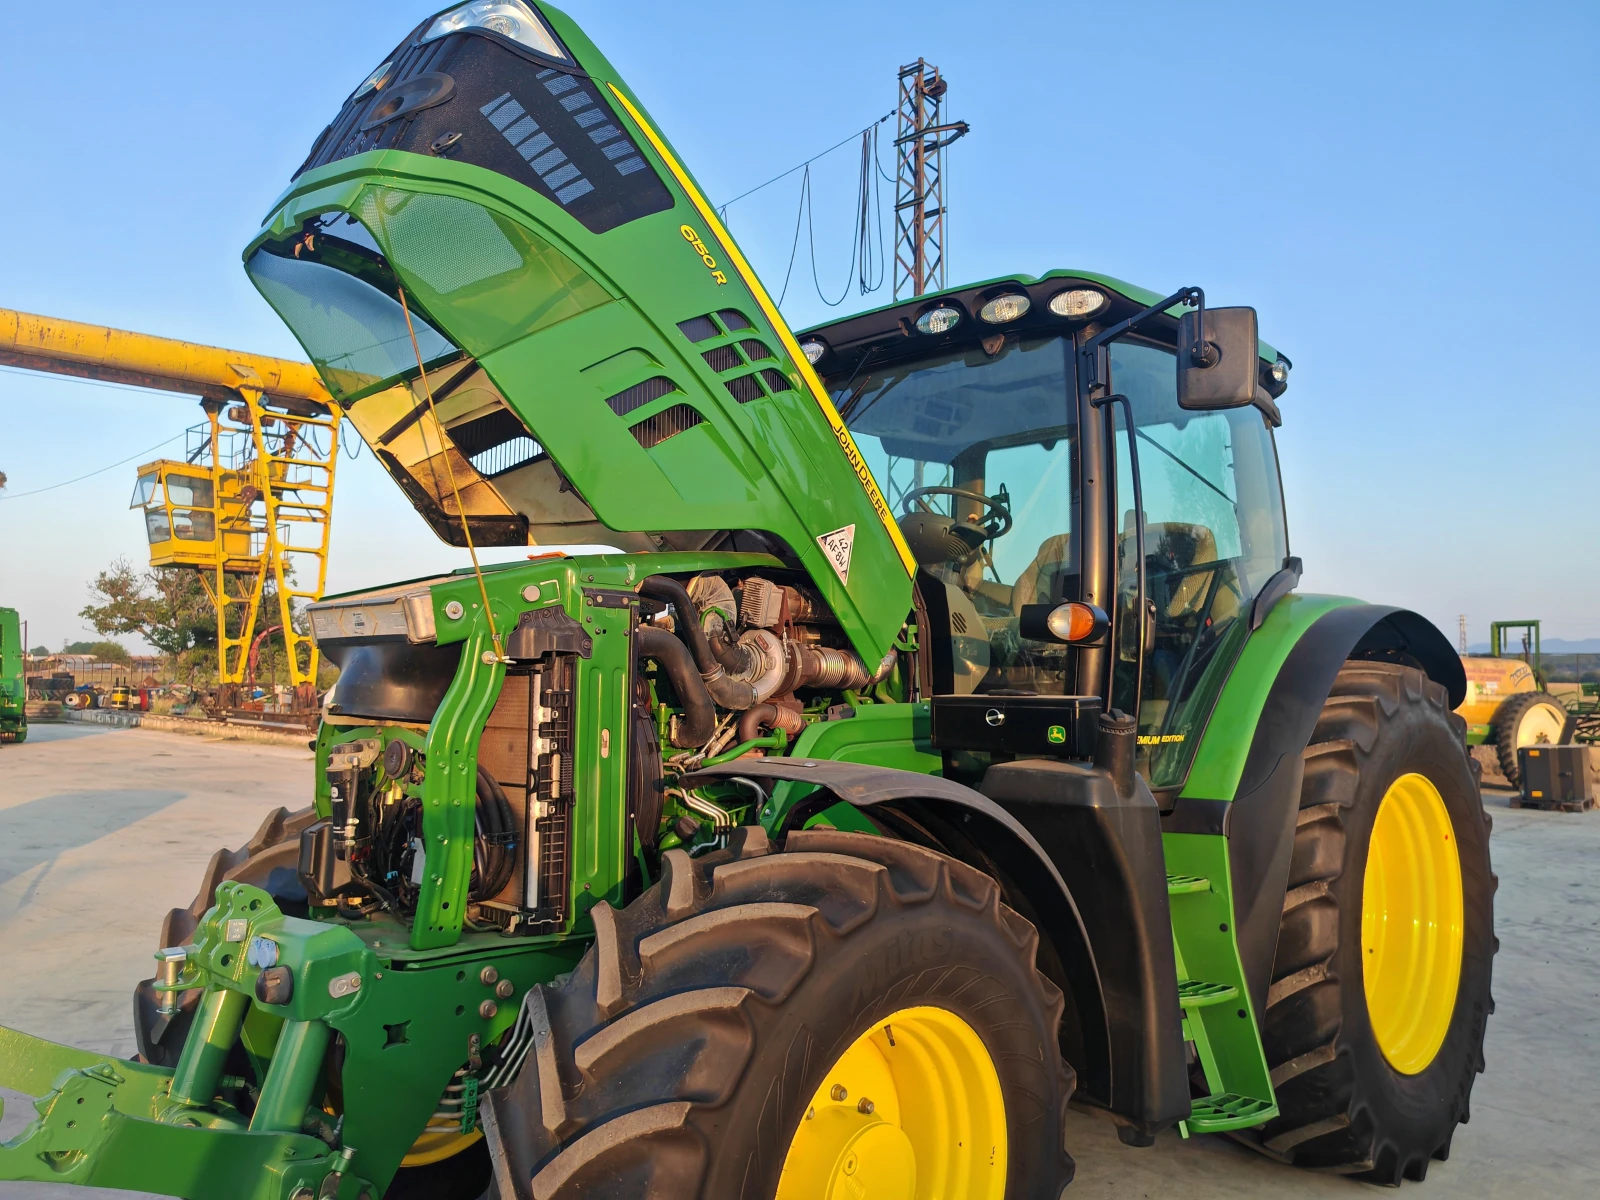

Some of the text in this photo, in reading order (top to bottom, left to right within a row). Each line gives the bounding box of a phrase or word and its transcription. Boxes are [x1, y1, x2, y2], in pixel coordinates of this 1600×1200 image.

[680, 224, 728, 286] 6150 R
[833, 426, 888, 520] JOHN DEERE
[1161, 734, 1185, 743] EDITION
